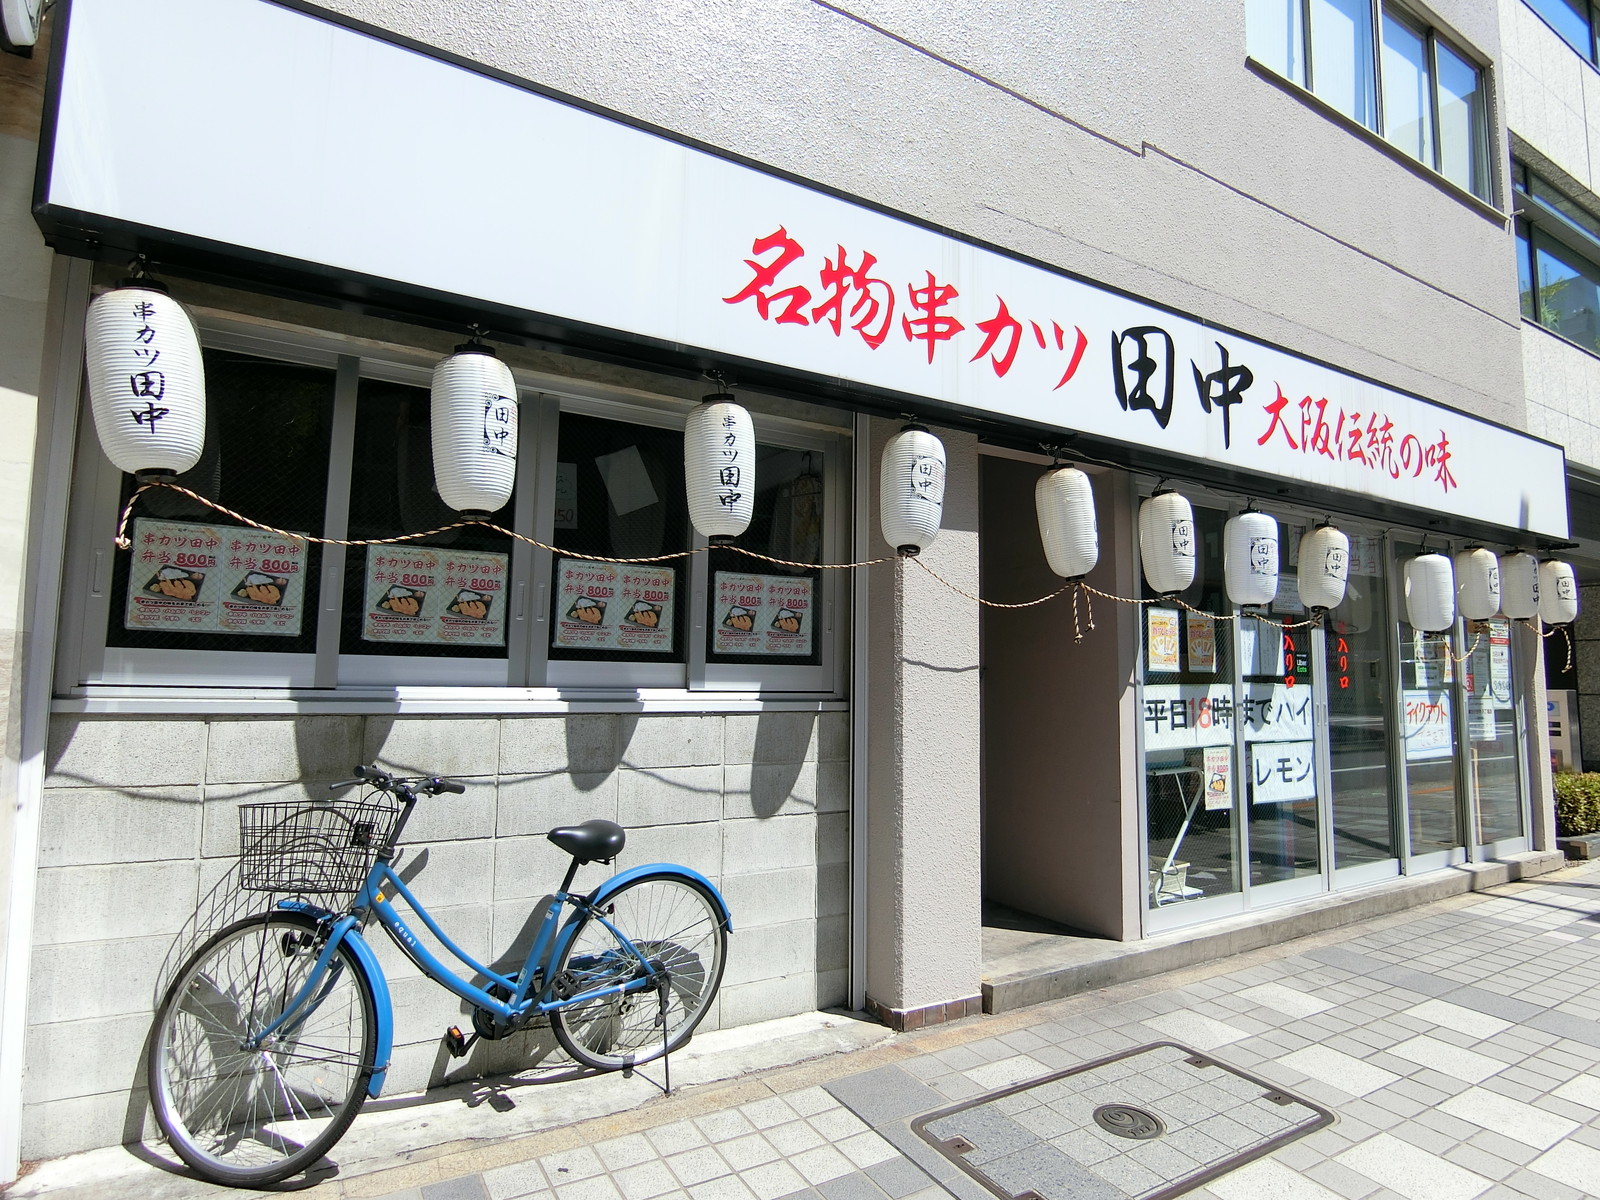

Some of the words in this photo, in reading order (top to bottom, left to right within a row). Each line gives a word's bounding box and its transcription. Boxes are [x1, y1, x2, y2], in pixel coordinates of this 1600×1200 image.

[130, 301, 169, 434] 串カツ田中
[722, 224, 1088, 391] 名物串カツ
[1111, 325, 1253, 449] 田中
[1257, 380, 1457, 493] 大阪伝統の味
[493, 406, 509, 445] 田中
[719, 415, 741, 512] 串カツ田中
[918, 463, 932, 492] 田中
[143, 532, 218, 550] 串カツ田中
[1178, 525, 1189, 548] 田中
[230, 540, 301, 557] 串カツ田中
[1257, 543, 1269, 568] 田中
[375, 556, 436, 570] 串カツ田中
[446, 561, 502, 575] 串カツ田中
[1331, 552, 1342, 572] 田中
[565, 570, 615, 583] 串カツ田中
[623, 575, 670, 587] 串カツ田中
[720, 582, 762, 593] 串カツ田中
[769, 585, 808, 596] 串カツ田中
[1256, 757, 1311, 786] レモン
